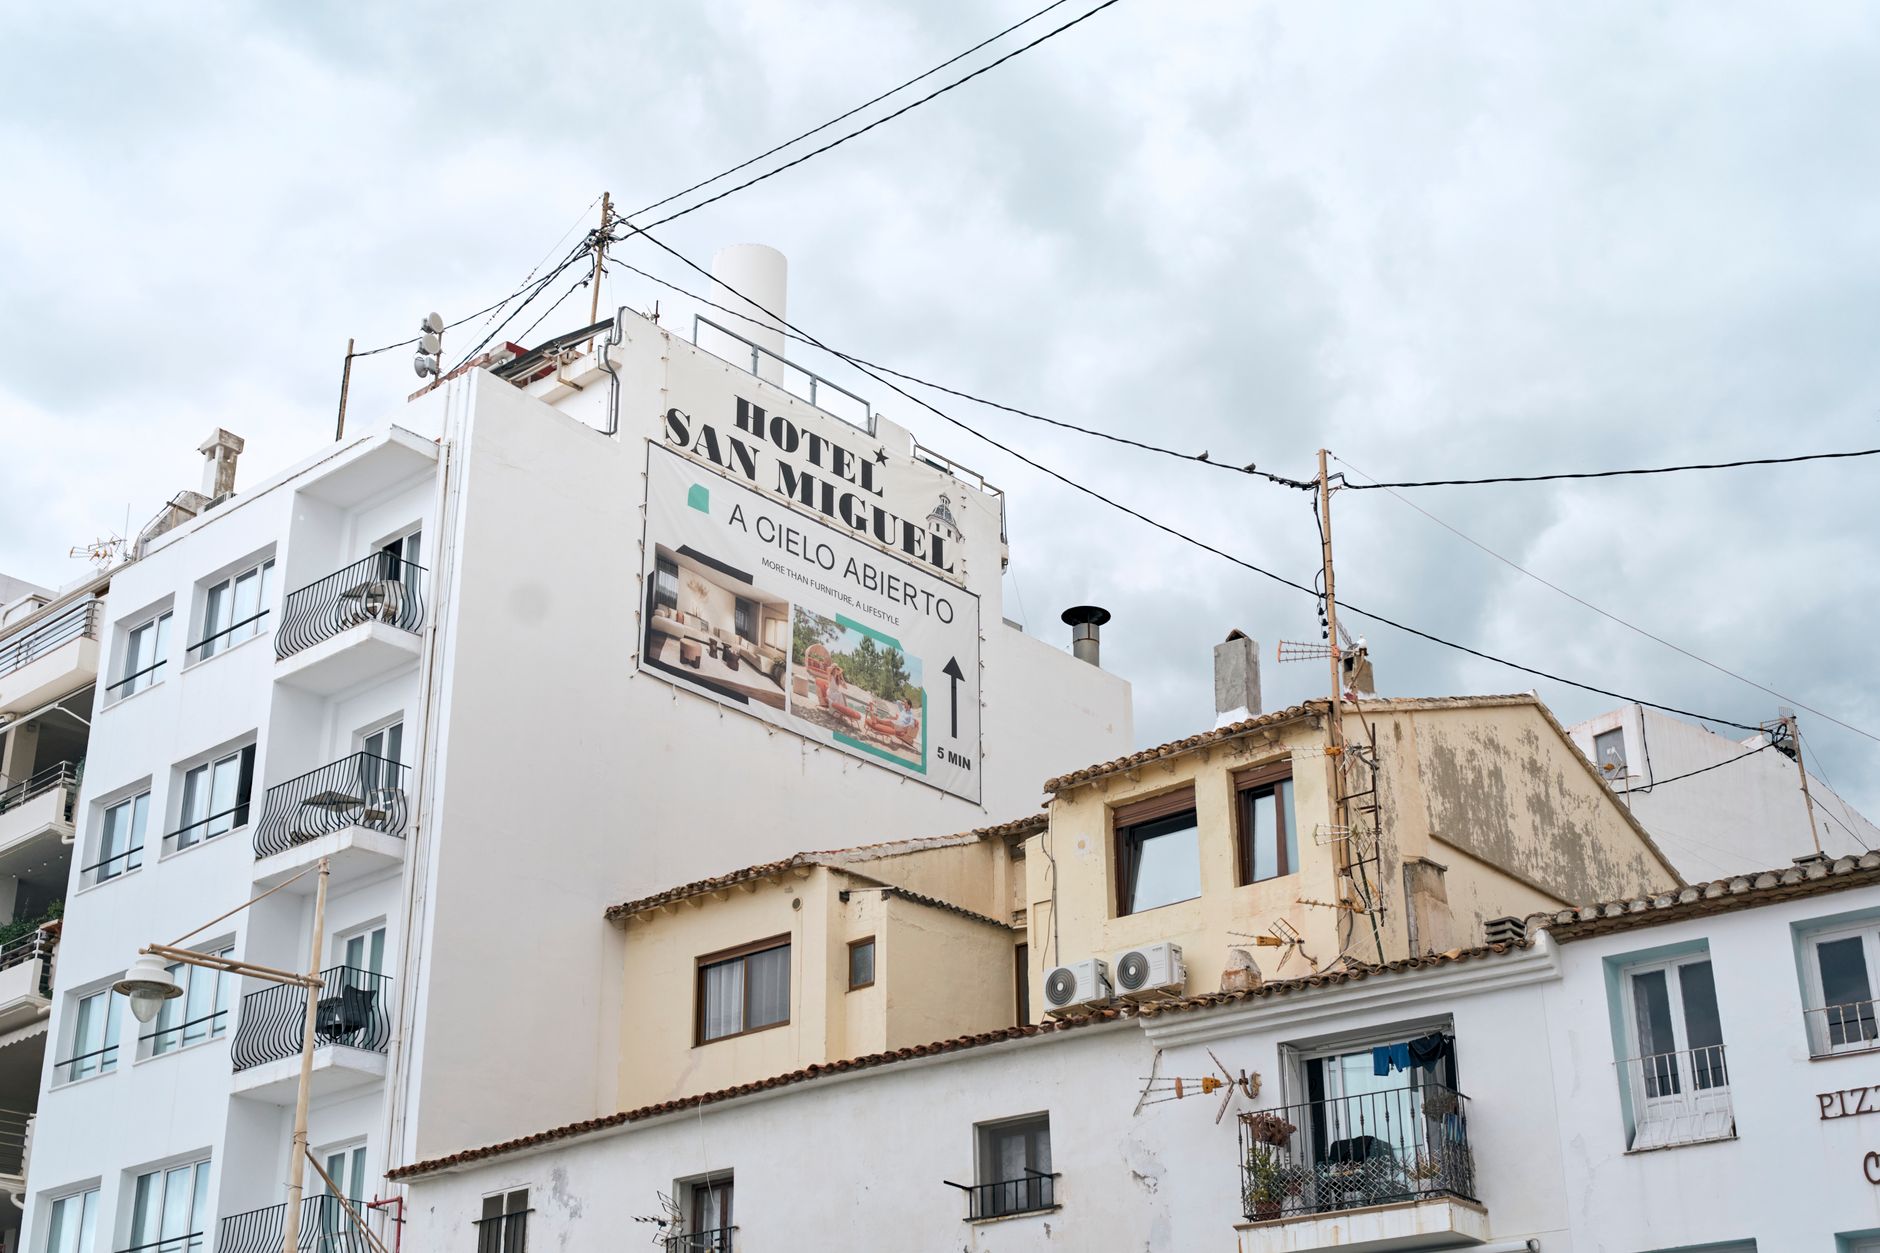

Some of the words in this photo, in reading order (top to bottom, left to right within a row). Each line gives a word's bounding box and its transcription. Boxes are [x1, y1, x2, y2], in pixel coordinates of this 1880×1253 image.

[665, 408, 760, 481] SAN
[775, 459, 955, 573] MIGUEL
[733, 394, 884, 498] HOTEL
[728, 503, 748, 532] A
[756, 516, 836, 571] CIELO
[843, 557, 954, 624] ABIERTO
[761, 557, 787, 575] MORE
[787, 568, 809, 585] THAN
[810, 577, 855, 608] FURNITURE,
[856, 600, 862, 609] A
[863, 601, 900, 626] LIFESTYLE
[937, 746, 945, 759] 5
[948, 750, 971, 771] MIN
